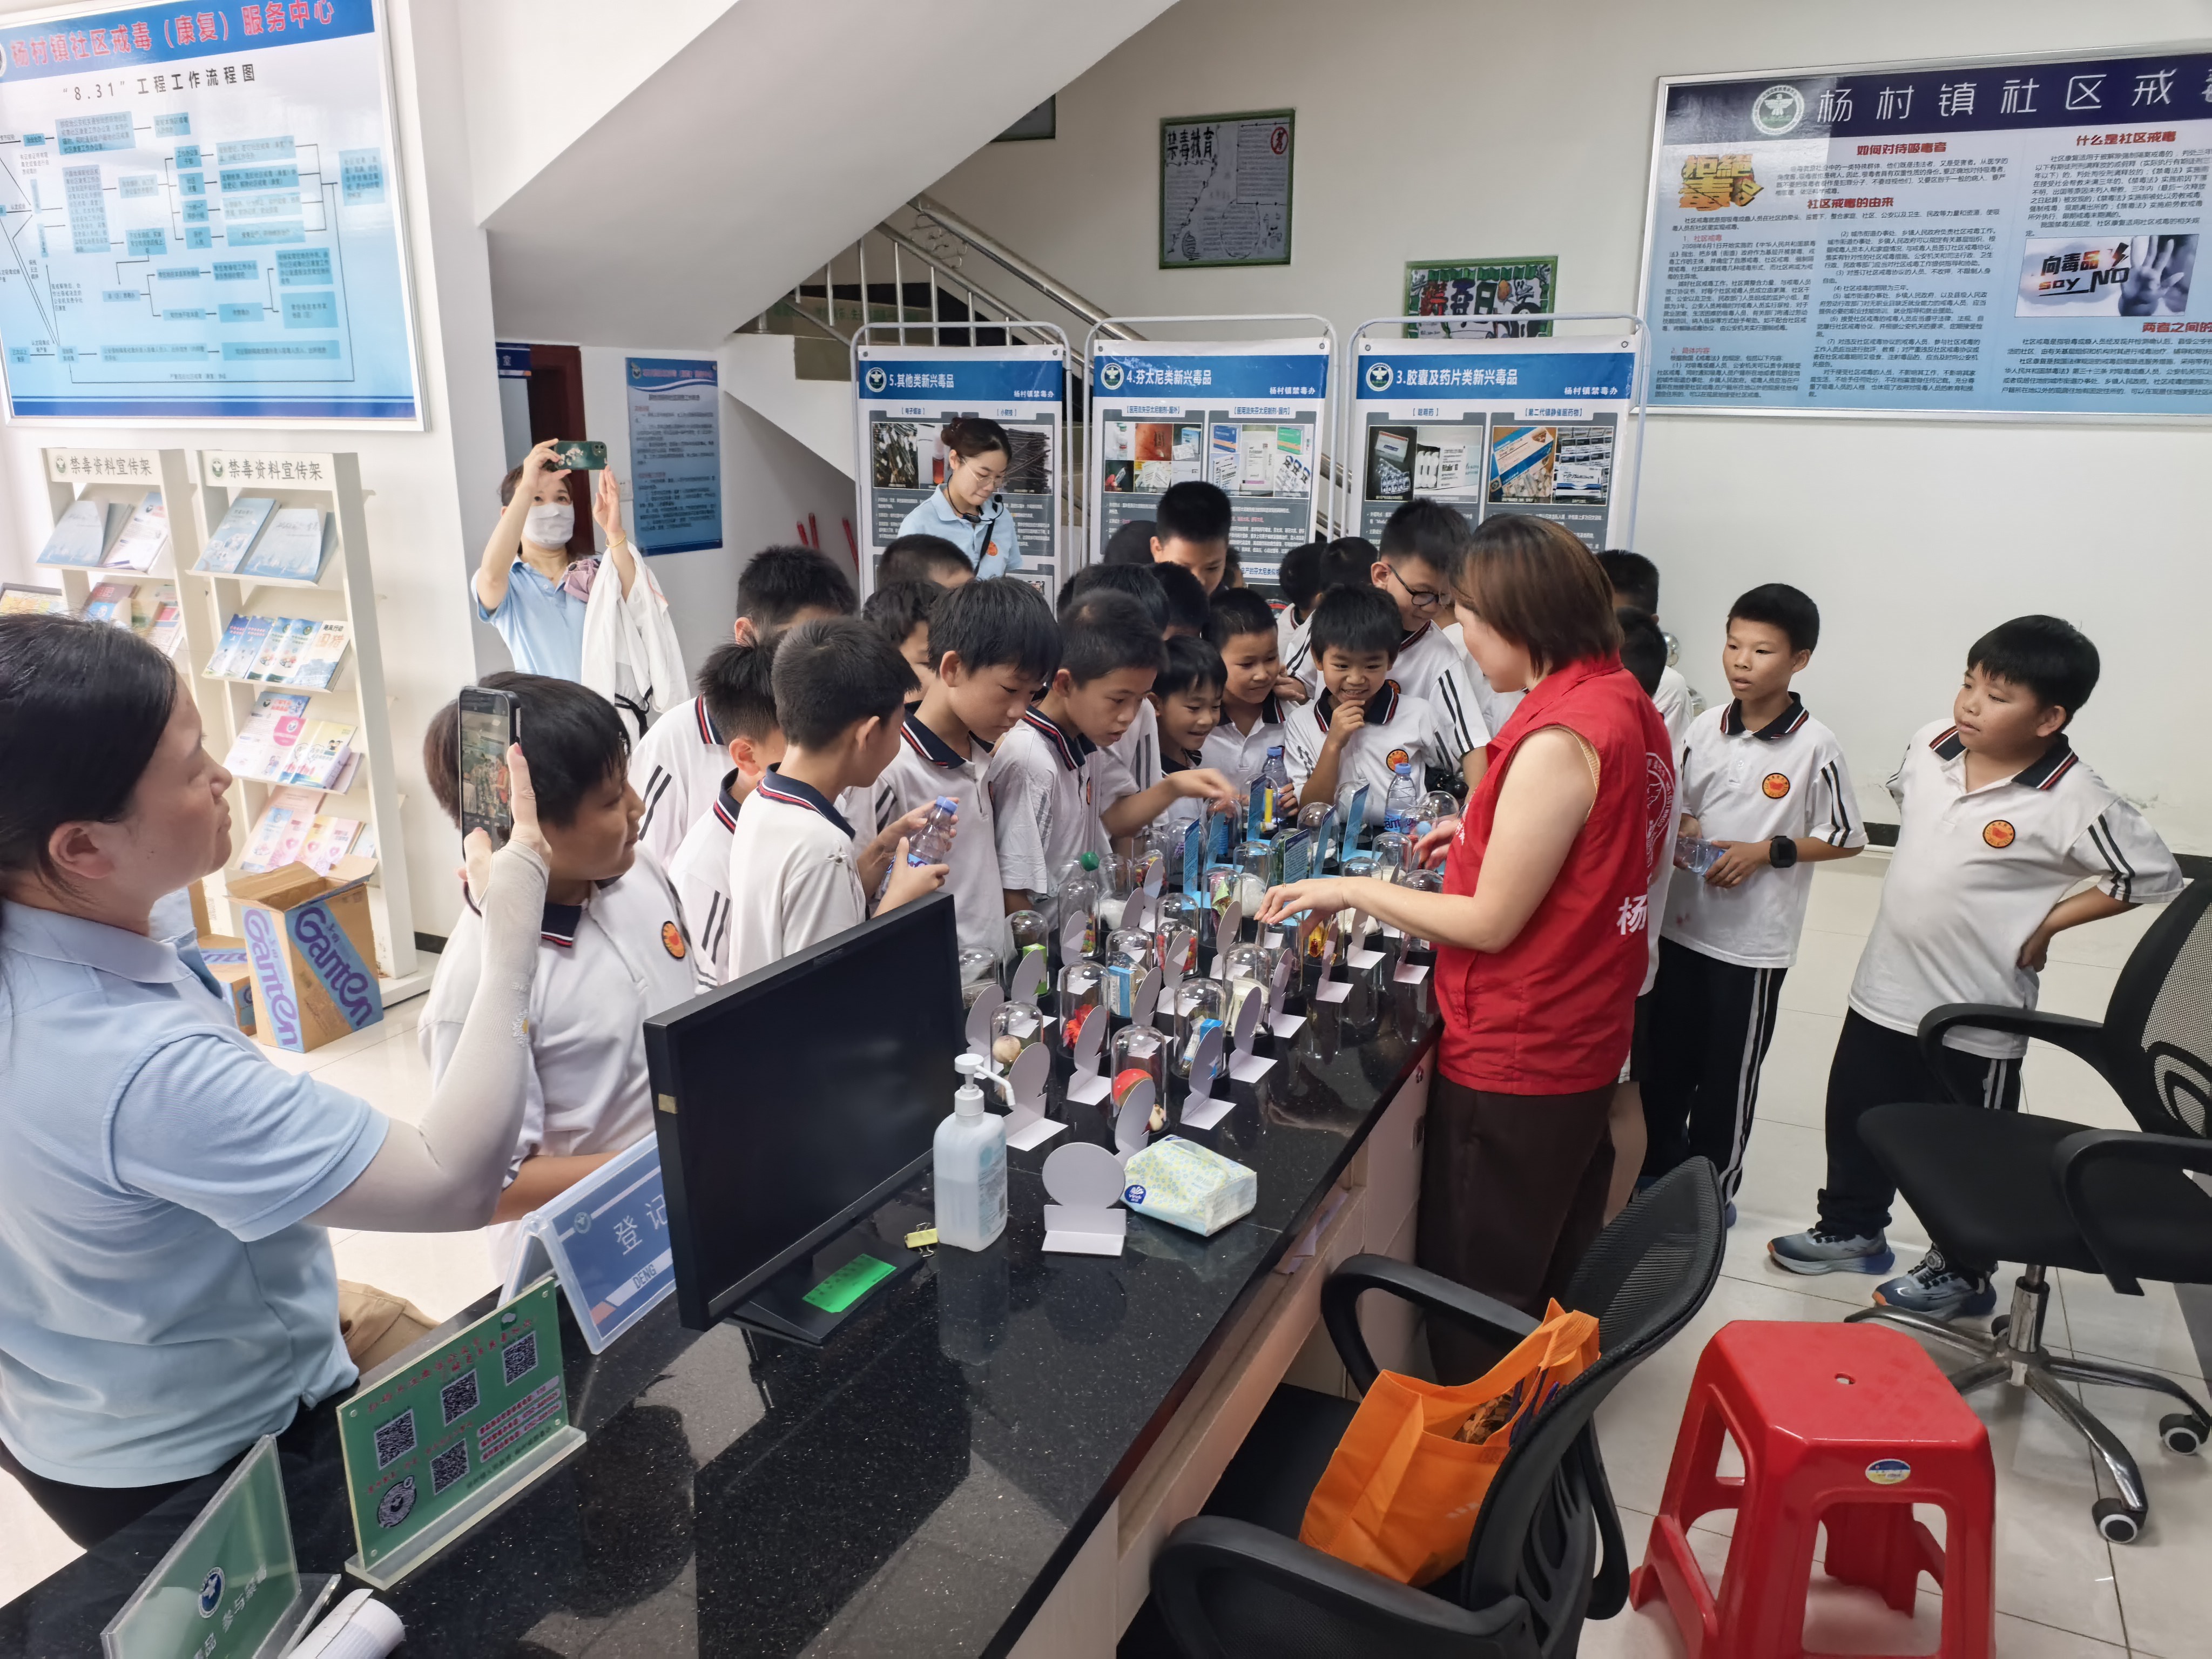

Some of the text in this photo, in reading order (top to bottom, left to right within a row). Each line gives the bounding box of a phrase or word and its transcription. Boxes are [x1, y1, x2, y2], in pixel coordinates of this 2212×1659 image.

[2076, 131, 2176, 146] 什么是社区戒毒
[1856, 142, 1947, 156] 如何对待吸毒者
[1806, 197, 1894, 210] 社区戒毒的由来
[2090, 267, 2129, 292] NO
[889, 373, 954, 388] 5.其他类新兴毒品
[1126, 369, 1212, 386] 4.芬太尼类新兴毒品
[1396, 368, 1518, 386] 3.胶囊及药片类新兴毒品
[1014, 390, 1054, 398] 杨村镇禁毒办
[1269, 386, 1316, 395] 杨村镇禁毒办
[1564, 386, 1618, 395] 杨村镇禁毒办
[70, 456, 153, 476] 禁毒资料宣传架
[228, 458, 324, 481] 禁毒资料宣传架
[1616, 893, 1648, 935] 杨
[294, 907, 373, 1027] Ganten
[244, 909, 298, 1046] Ganten
[613, 1193, 667, 1256] 登记
[633, 1264, 657, 1290] DENG
